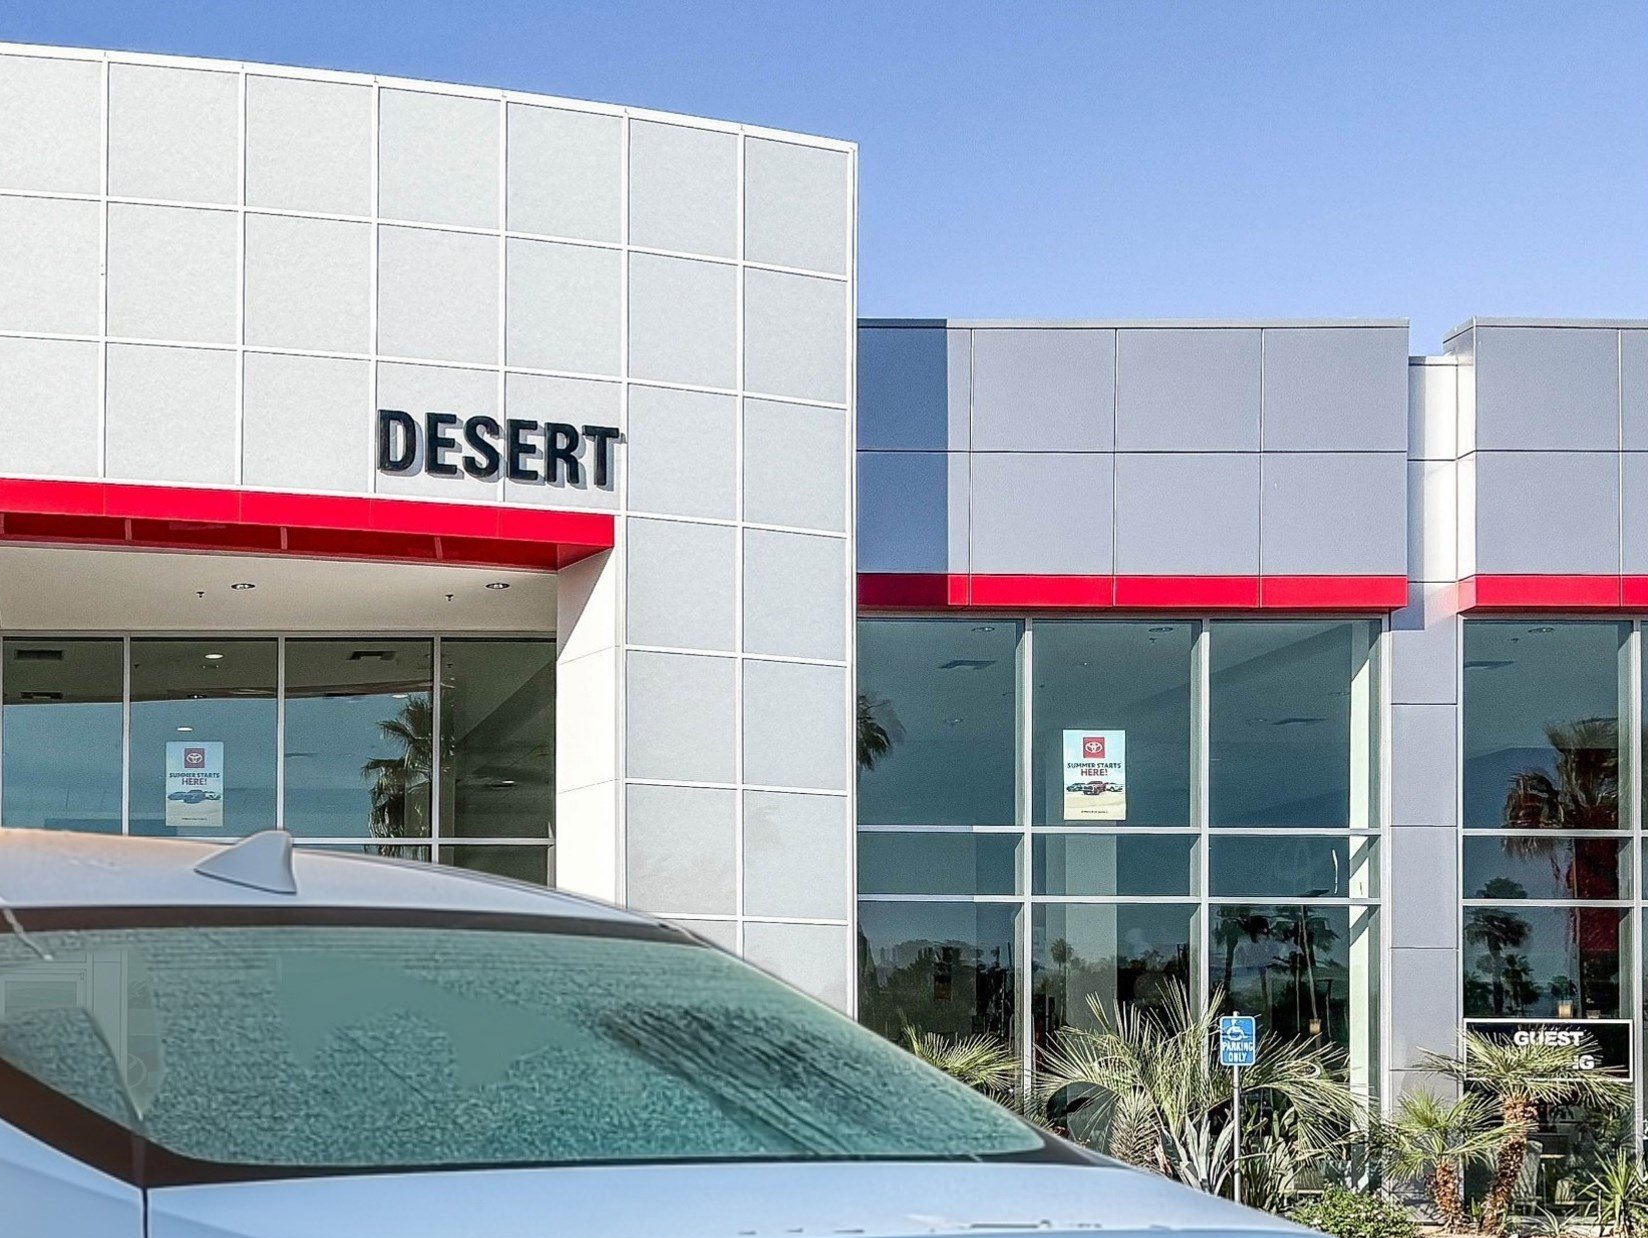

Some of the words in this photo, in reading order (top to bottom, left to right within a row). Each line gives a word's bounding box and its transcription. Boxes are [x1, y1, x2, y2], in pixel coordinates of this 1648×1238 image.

[377, 409, 619, 486] DESERT
[1081, 768, 1108, 776] HERE!
[1513, 1031, 1584, 1047] GUEST
[1222, 1041, 1253, 1052] PARKING
[1228, 1051, 1247, 1063] ONLY
